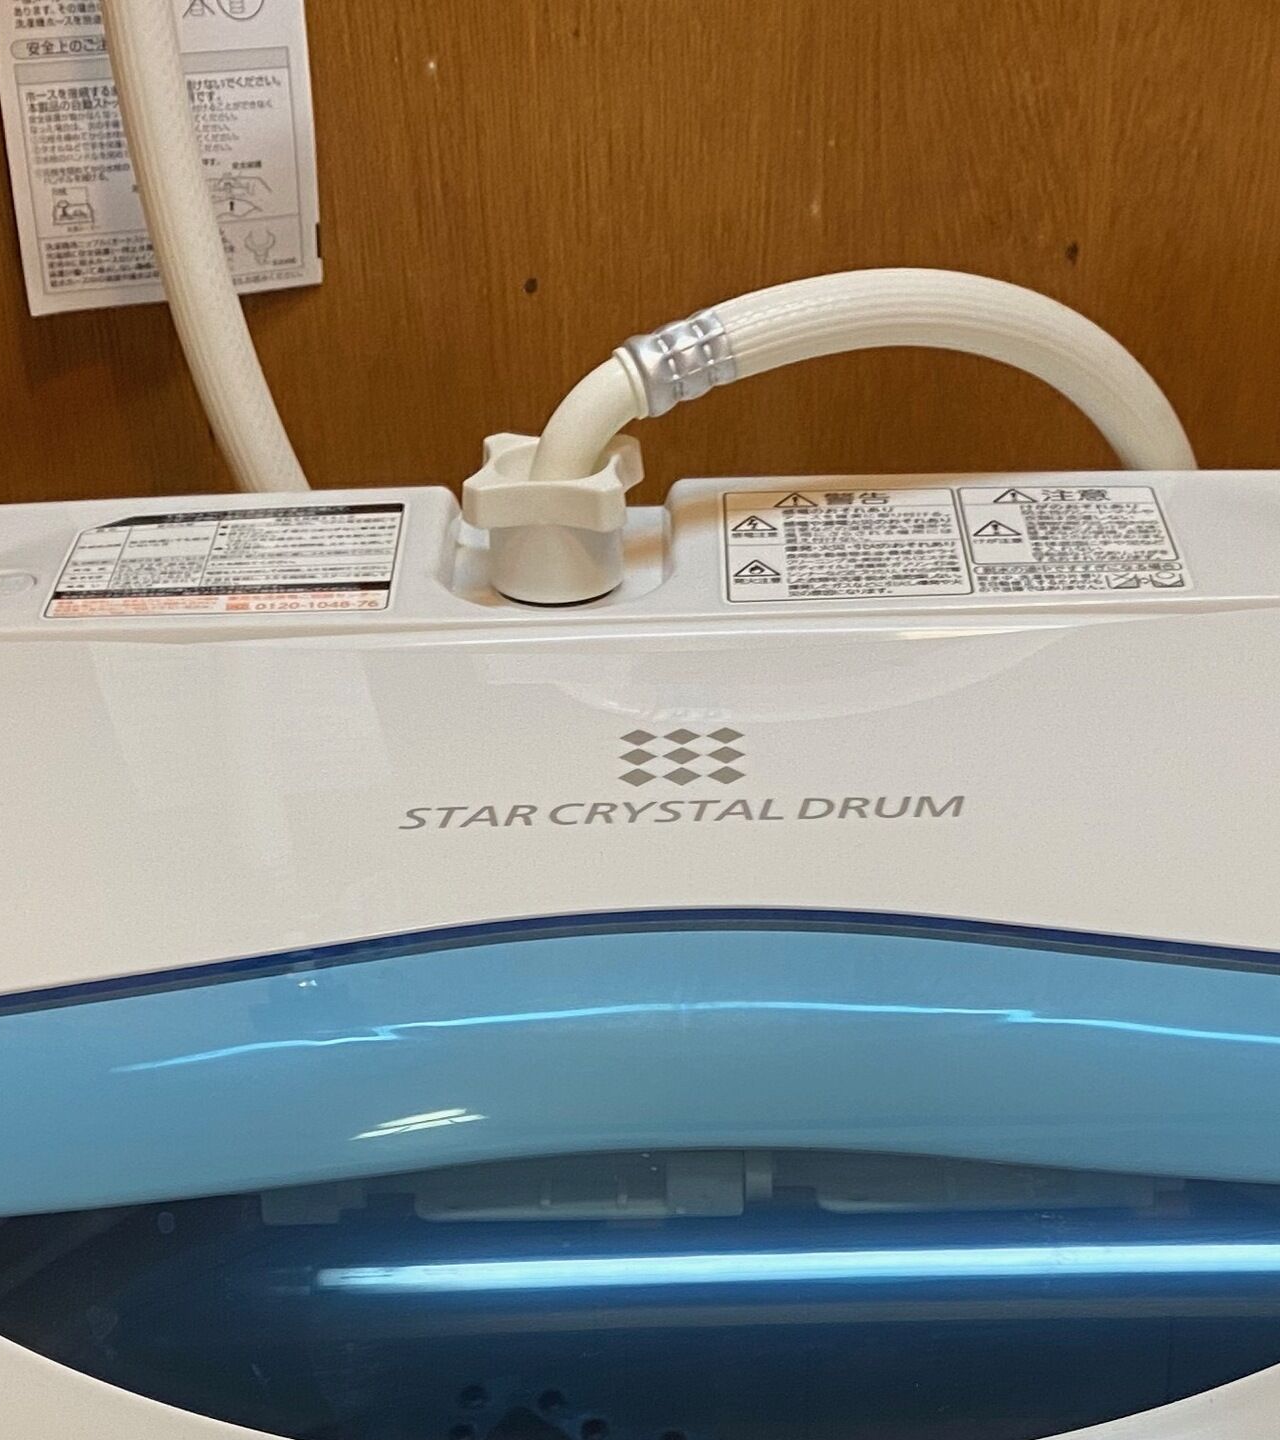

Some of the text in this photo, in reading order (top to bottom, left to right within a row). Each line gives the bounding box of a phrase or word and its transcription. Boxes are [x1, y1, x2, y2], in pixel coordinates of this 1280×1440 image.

[1042, 489, 1111, 501] 注意
[399, 795, 965, 830] STAR CRYSTAL DRUM
